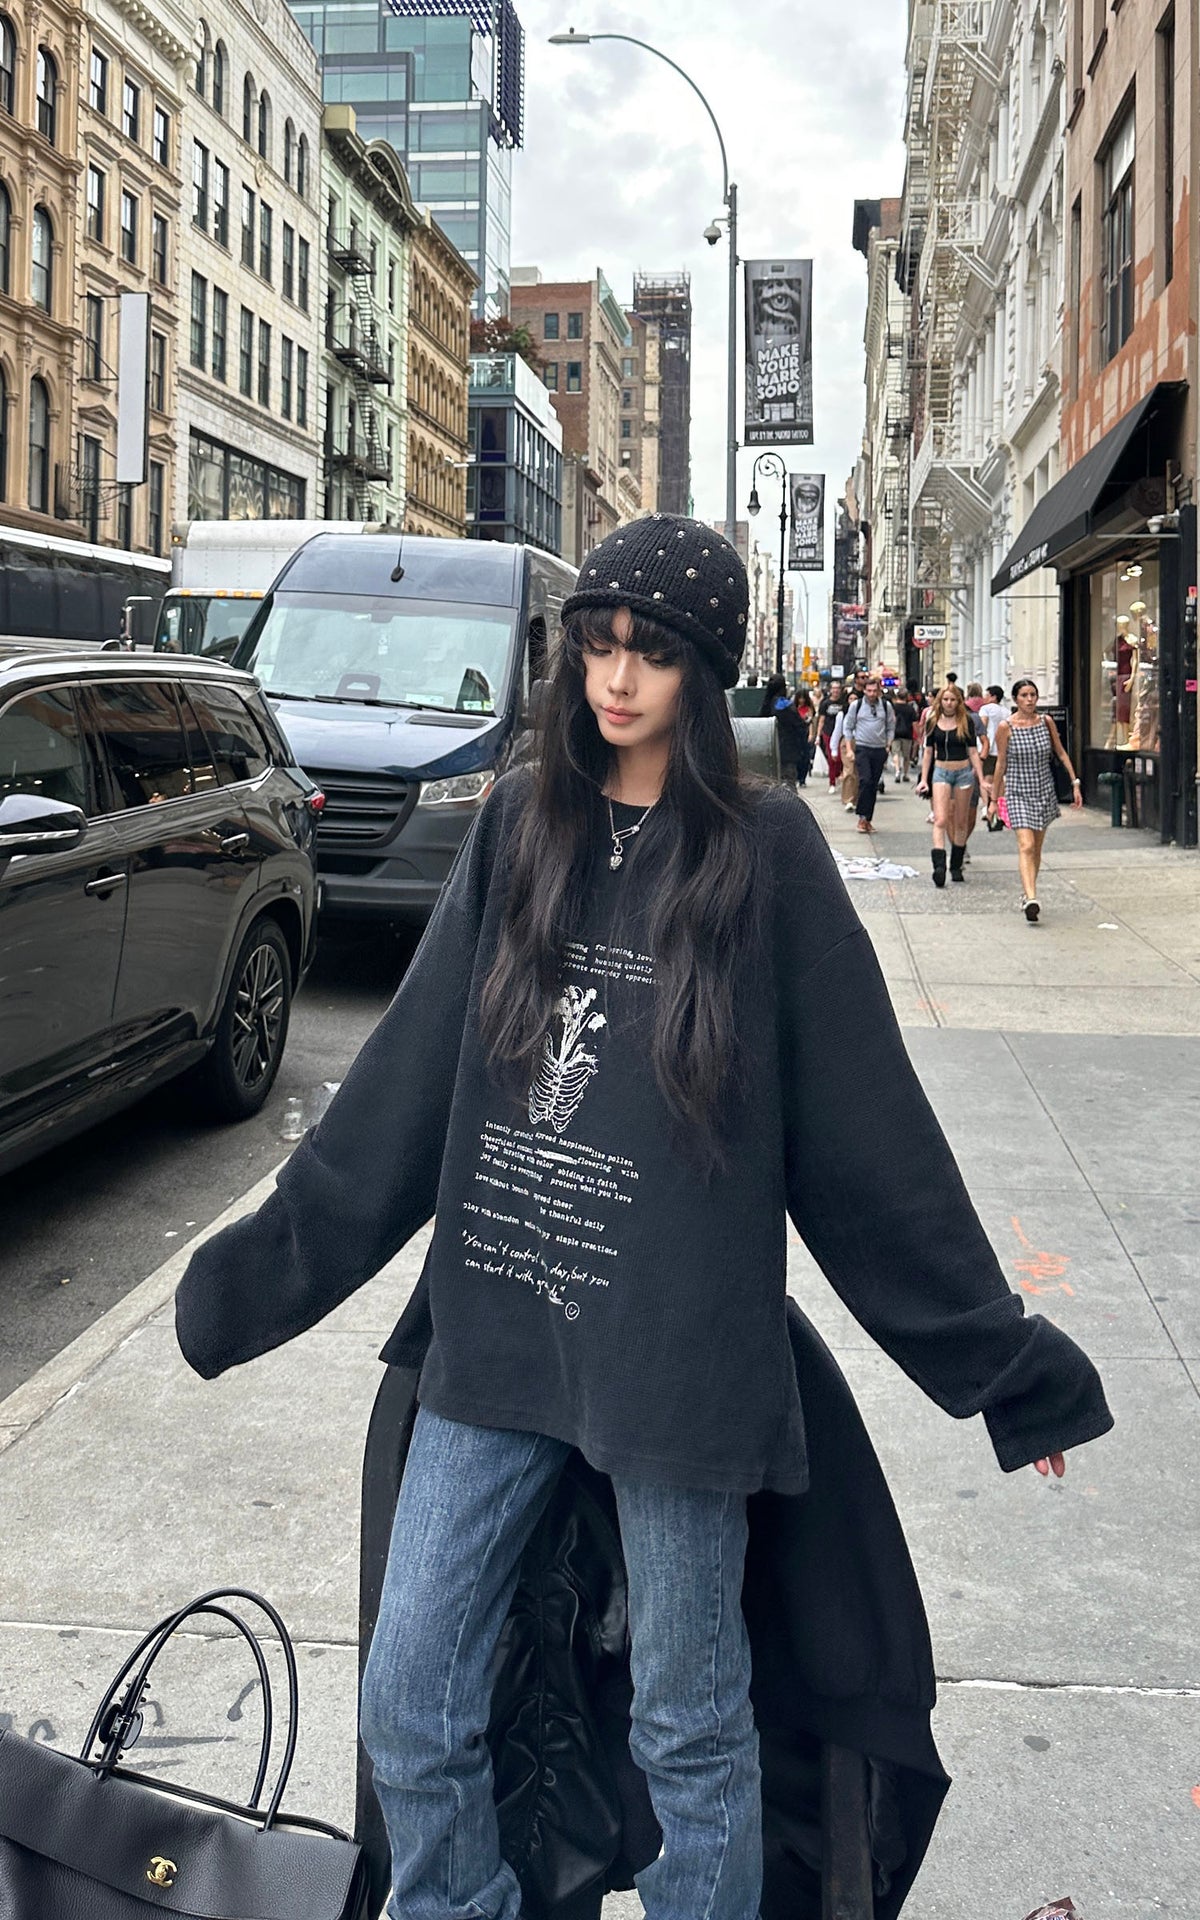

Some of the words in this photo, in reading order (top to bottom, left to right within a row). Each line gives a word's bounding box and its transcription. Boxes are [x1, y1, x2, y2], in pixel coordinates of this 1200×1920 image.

[758, 343, 799, 362] MAKE
[758, 356, 799, 375] YOUR
[757, 368, 800, 387] MARK
[757, 380, 800, 400] SOHO
[927, 628, 944, 637] Valley
[624, 963, 653, 974] quietly
[558, 1138, 592, 1153] happiness
[591, 1149, 605, 1160] like
[607, 1155, 633, 1168] pollen
[480, 1152, 491, 1162] joy
[549, 1178, 577, 1191] protect
[580, 1184, 596, 1194] what
[597, 1189, 611, 1198] you
[614, 1191, 632, 1203] love
[536, 1159, 554, 1169] color
[557, 1168, 585, 1183] abiding
[587, 1175, 595, 1184] in
[597, 1178, 618, 1190] faith
[577, 1156, 612, 1173] flowering
[621, 1169, 639, 1180] with
[553, 1198, 574, 1210] cheer
[548, 1209, 582, 1226] thankful
[584, 1219, 605, 1232] daily
[555, 1235, 579, 1246] simple
[465, 1258, 480, 1269] can
[483, 1261, 505, 1276] start
[506, 1264, 514, 1278] it
[515, 1268, 534, 1285] with
[483, 1240, 509, 1256] can't
[571, 1266, 588, 1282] but
[589, 1275, 609, 1287] you
